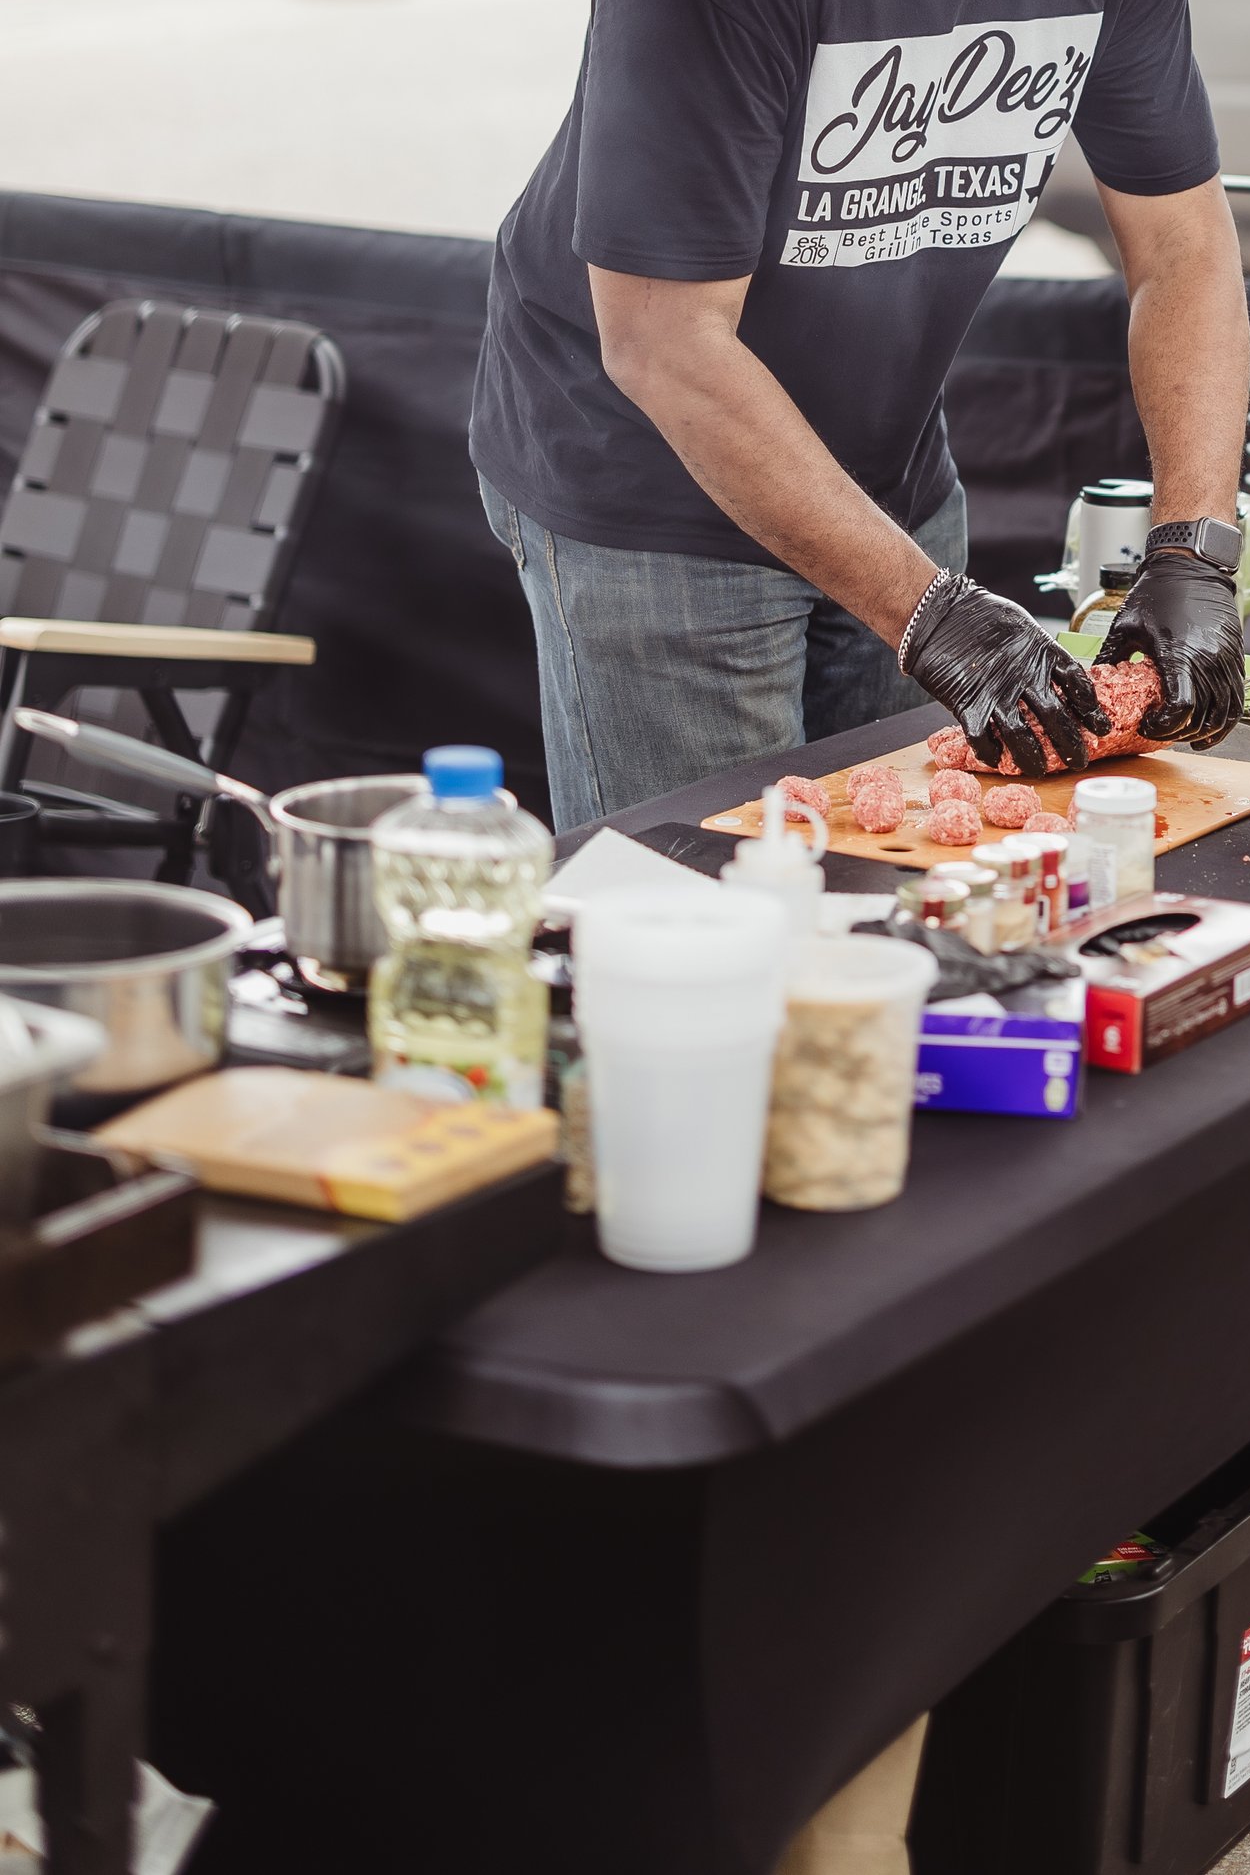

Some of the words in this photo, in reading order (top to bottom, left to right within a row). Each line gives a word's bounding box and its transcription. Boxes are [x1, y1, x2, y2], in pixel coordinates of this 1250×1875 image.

[797, 190, 832, 222] LA
[934, 163, 1021, 198] TEXAS
[797, 234, 827, 248] est.
[842, 228, 886, 247] Best
[940, 209, 1012, 231] Sports
[788, 246, 829, 264] 2019
[864, 240, 907, 261] Grill
[911, 236, 921, 251] in
[930, 229, 992, 245] Texas
